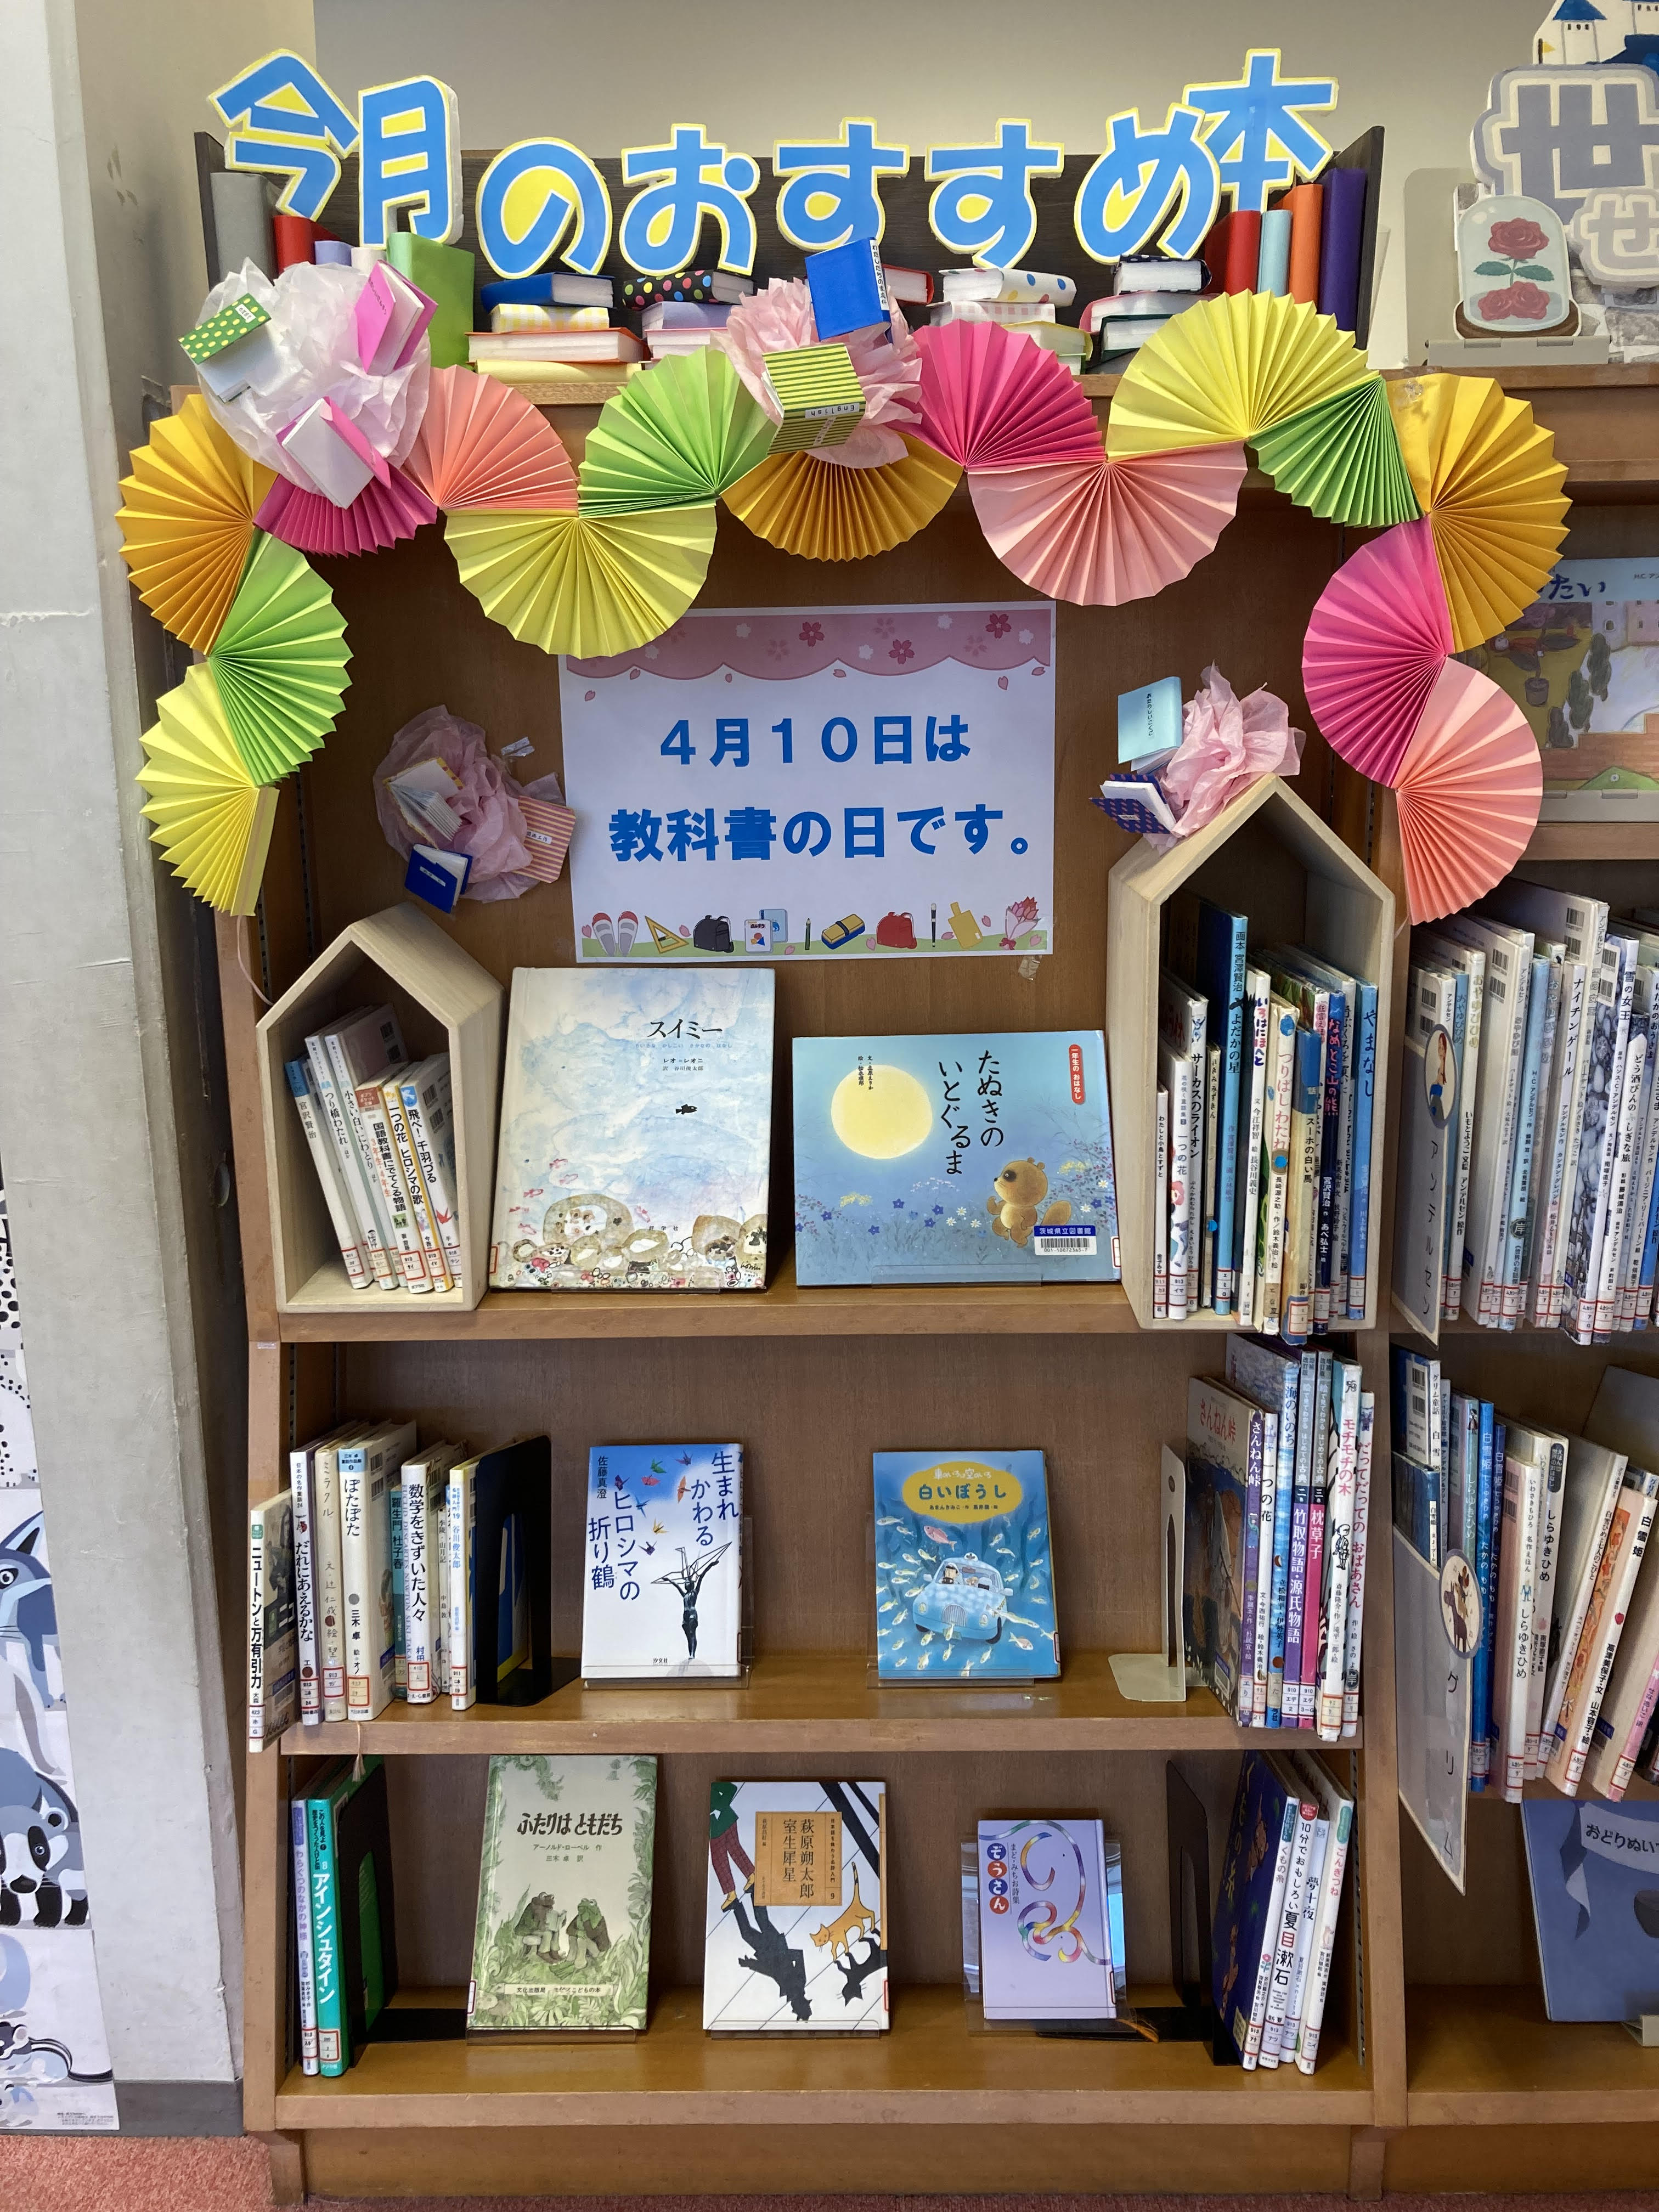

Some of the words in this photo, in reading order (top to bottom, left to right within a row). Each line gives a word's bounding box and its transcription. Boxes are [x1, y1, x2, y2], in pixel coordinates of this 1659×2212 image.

[209, 48, 1339, 279] 今月のおすすめ本
[811, 404, 855, 417] English
[660, 715, 971, 767] 4月10日は
[609, 804, 1029, 862] 教科書の日です。
[1234, 931, 1245, 951] 画本
[1233, 953, 1245, 993] 宮澤賢治
[1619, 971, 1635, 1021] 雪の女王
[647, 1018, 723, 1040] スイミー
[1254, 997, 1269, 1066] いろはにほへと
[1468, 975, 1484, 1049] おやゆびひめ
[1562, 978, 1586, 1077] ナイチンゲール
[1070, 1047, 1080, 1073] 一年生の
[1227, 1018, 1243, 1075] よだかの星
[1323, 1018, 1342, 1116] なめとこ山の熊
[1362, 1009, 1378, 1097] やまなし
[977, 1049, 1004, 1148] たぬきの
[1073, 1073, 1082, 1099] おはなし
[1190, 1053, 1203, 1158] サーカスのライオン
[1275, 1053, 1294, 1107] つりばし
[299, 1102, 317, 1139] 宮沢賢治
[325, 1092, 348, 1144] つり橋わたれ
[345, 1090, 374, 1170] 小さい白いにわとり
[939, 1060, 971, 1175] いとぐるま
[1251, 1108, 1262, 1140] 今江祥智
[1273, 1110, 1290, 1151] わたれ
[373, 1122, 407, 1212] 国語教科書にでてくる物語
[388, 1106, 408, 1144] 一つの花
[400, 1149, 424, 1205] ヒロシマの歌
[417, 1140, 437, 1183] 千羽づる
[1177, 1136, 1188, 1176] 一つの花
[1248, 1156, 1260, 1197] 長谷川義史
[1304, 1118, 1316, 1184] スーホの白い馬
[1284, 1386, 1297, 1447] 海のいのち
[596, 1455, 608, 1499] 佐藤真澄
[1248, 1421, 1262, 1487] さんねん峠
[1296, 1433, 1307, 1483] はじめての古典
[1313, 1434, 1325, 1484] はじめての古典
[1337, 1419, 1358, 1496] モチモチの木
[322, 1462, 334, 1519] ミラクル
[343, 1479, 362, 1537] ぽたぽた
[391, 1497, 403, 1531] 羅生門
[690, 1479, 714, 1547] かわる
[712, 1450, 739, 1520] 生まれ
[918, 1483, 1007, 1500] 白いぼうし
[1261, 1464, 1274, 1522] 一つの花
[1353, 1441, 1372, 1533] だってだっての
[392, 1535, 403, 1569] 杜子春
[408, 1483, 427, 1623] 数学をきずいた人々
[452, 1525, 461, 1568] 谷川俊太郎
[588, 1515, 614, 1590] 折り鶴
[614, 1491, 640, 1601] ヒロシマの
[1310, 1509, 1324, 1560] 枕草子
[1539, 1509, 1556, 1582] しらゆきひめ
[1632, 1516, 1652, 1558] 白雪姫
[295, 1541, 314, 1642] だれにあえるかな
[1287, 1508, 1308, 1644] 竹取物語・源氏物語
[1349, 1541, 1365, 1609] おばあさん
[251, 1547, 263, 1689] ニュートンと万有引力
[351, 1609, 360, 1627] 三木
[1516, 1608, 1530, 1679] しらゆきひめ
[517, 1812, 573, 1836] ふたりは
[573, 1812, 623, 1836] ともだち
[533, 1843, 589, 1852] アーノルド・ローベル
[782, 1819, 797, 1883] 室生犀星
[799, 1819, 815, 1900] 萩原朔太郎
[989, 1845, 1006, 1911] ぞうさん
[1010, 1843, 1020, 1905] まど・みちお詩集
[1275, 1846, 1289, 1884] くもの糸
[1330, 1848, 1346, 1897] ごんぎつね
[830, 1892, 836, 1900] 9
[1302, 1876, 1319, 1921] 夢十夜
[312, 1873, 336, 2004] アインシュタイン
